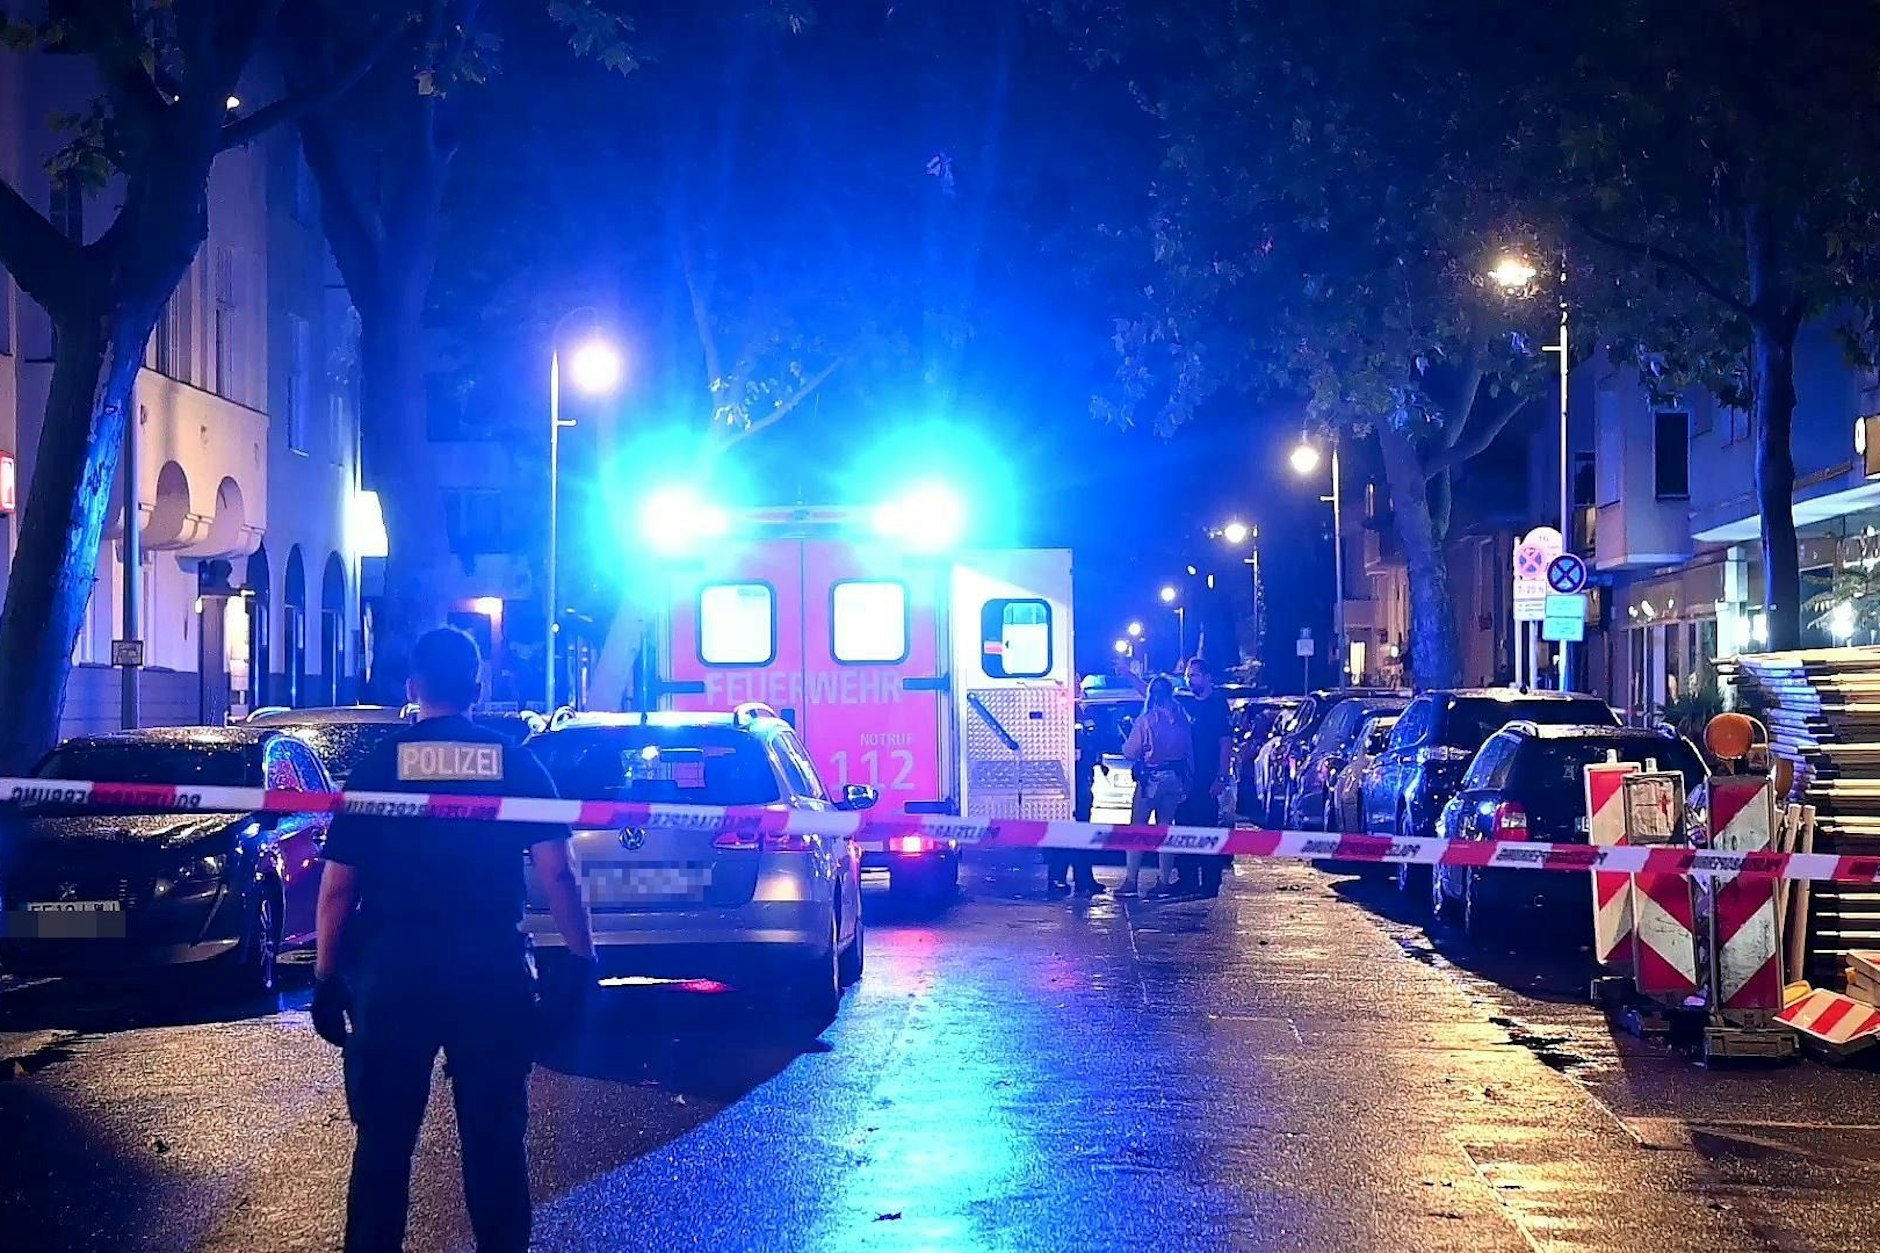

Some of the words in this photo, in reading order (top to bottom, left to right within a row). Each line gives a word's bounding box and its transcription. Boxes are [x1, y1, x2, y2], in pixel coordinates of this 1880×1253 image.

[706, 669, 901, 705] FEUERWEHR
[860, 733, 914, 747] NOTRUF
[403, 747, 498, 775] POLIZEI
[830, 749, 915, 791] 112
